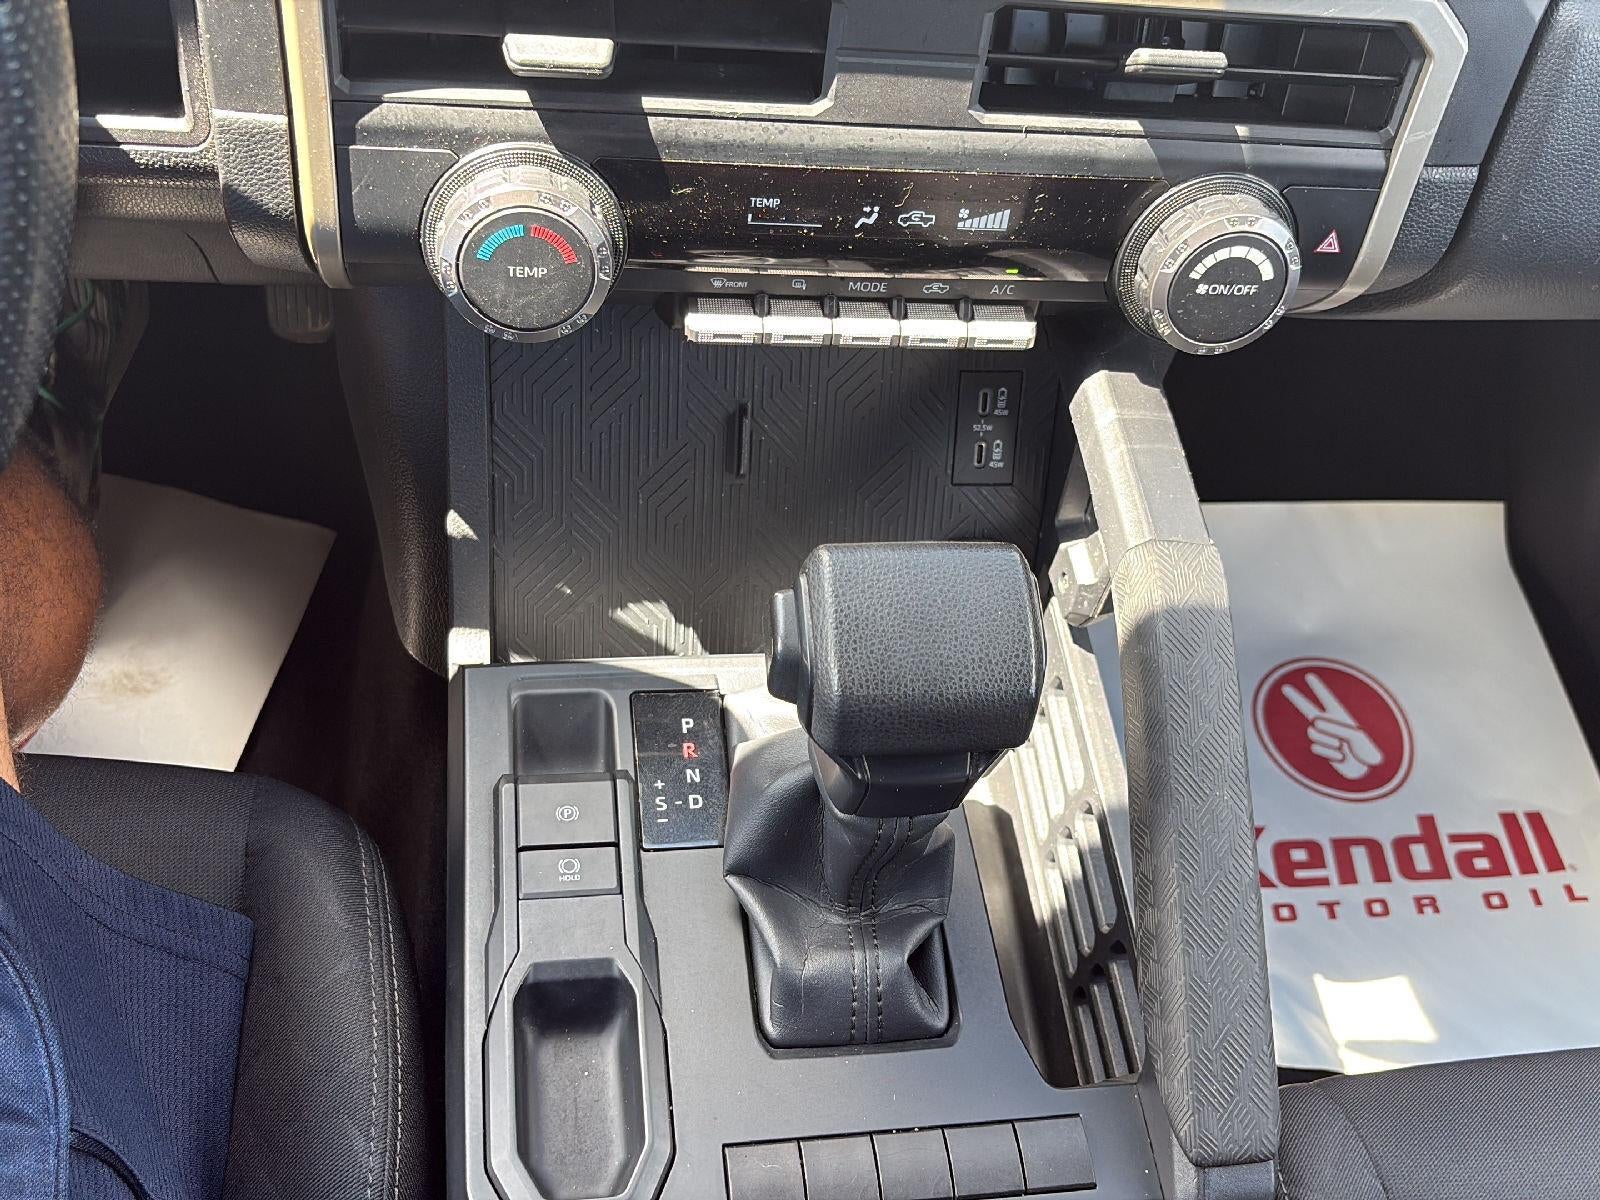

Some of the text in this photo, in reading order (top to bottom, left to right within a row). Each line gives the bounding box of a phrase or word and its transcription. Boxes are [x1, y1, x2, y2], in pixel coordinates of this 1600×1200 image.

[750, 197, 781, 208] TEMP
[506, 265, 548, 278] TEMP
[725, 280, 749, 289] FRONT
[848, 281, 888, 293] MODE
[990, 284, 1015, 295] A/C
[1208, 284, 1259, 295] ON/OFF
[973, 424, 993, 432] 52.5W
[681, 717, 694, 734] P
[683, 741, 698, 758] R
[686, 768, 700, 783] N
[655, 794, 703, 811] S D
[1271, 883, 1590, 923] OTOR OIL
